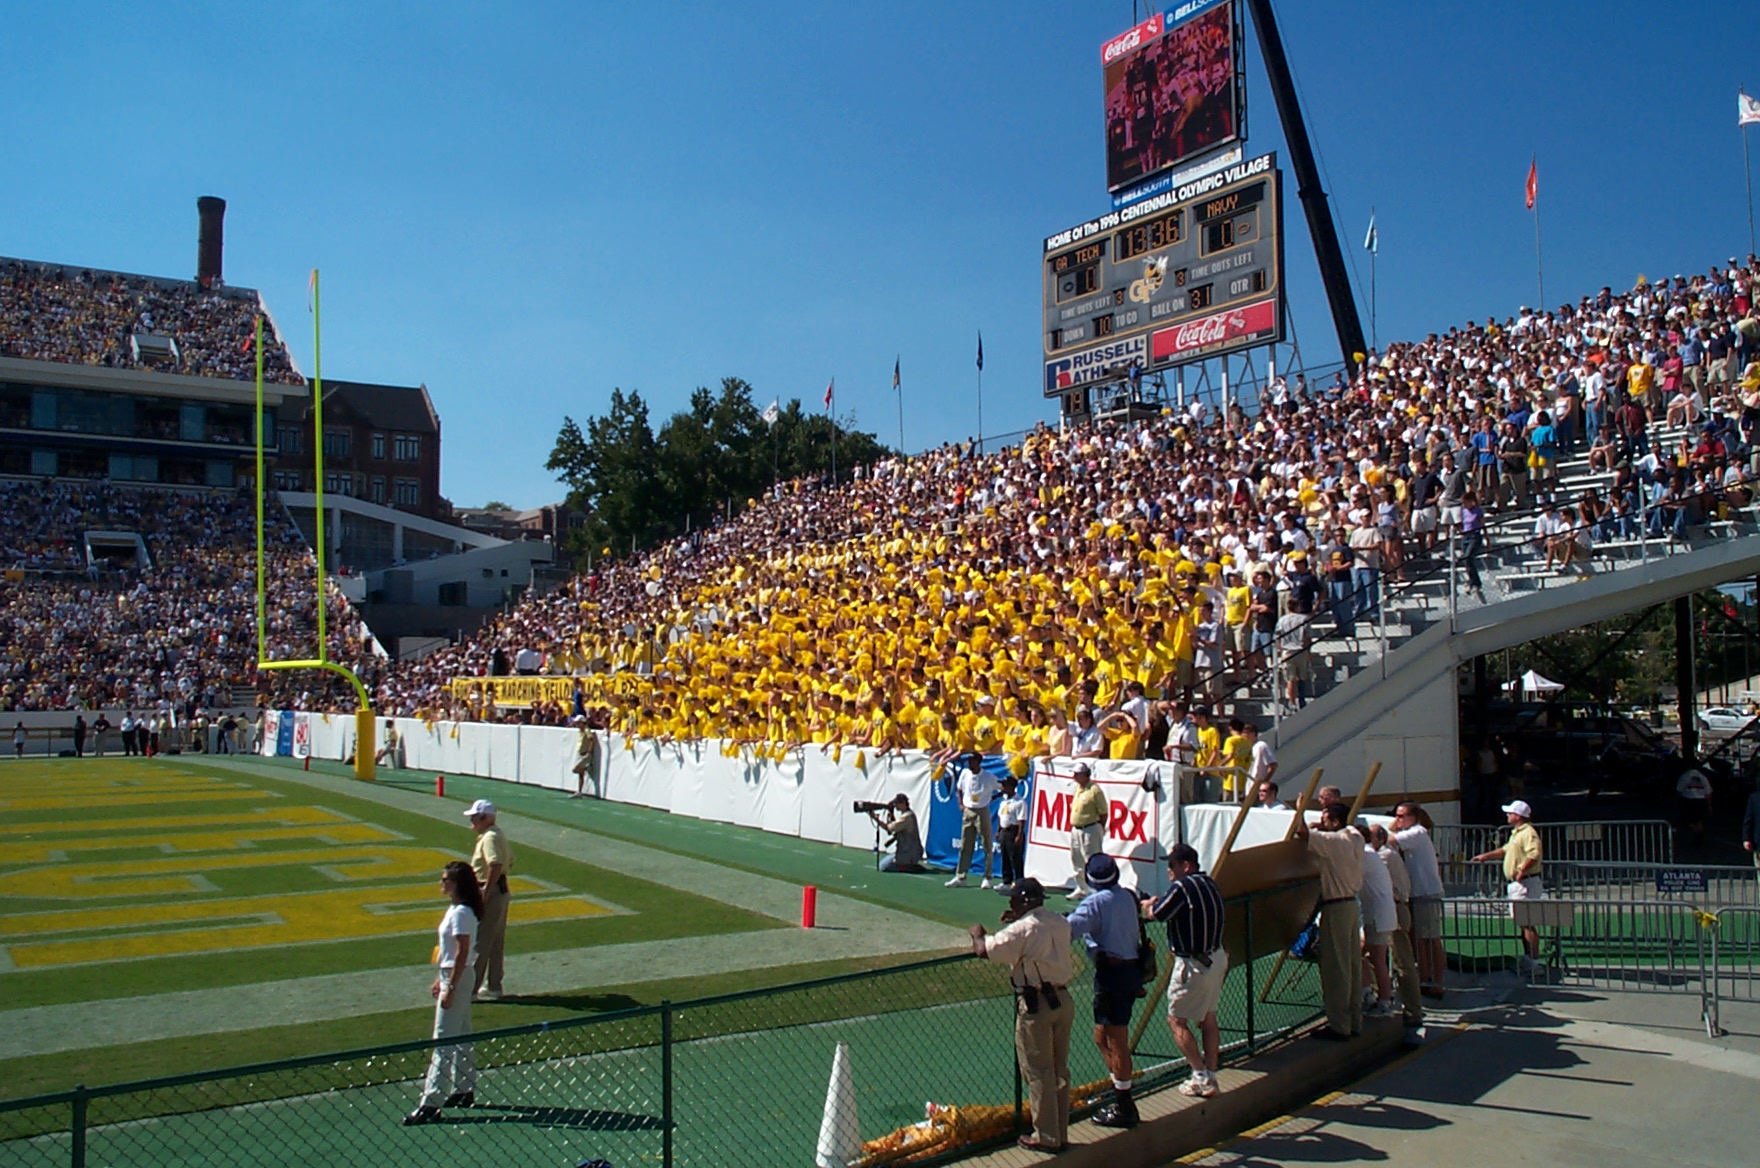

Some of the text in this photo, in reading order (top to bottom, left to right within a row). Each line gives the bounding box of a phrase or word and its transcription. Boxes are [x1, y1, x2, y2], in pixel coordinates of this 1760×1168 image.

[1047, 229, 1072, 250] HOME
[1072, 226, 1083, 240] Of
[1084, 221, 1099, 236] The
[1100, 212, 1119, 231] 1996
[1121, 189, 1178, 222] CENTENNIAL
[1178, 173, 1224, 200] OLYMPIC
[1224, 154, 1270, 183] VILLAGE
[1206, 193, 1239, 218] NAVY
[1075, 244, 1100, 263] TECH
[1191, 266, 1208, 279] TIME
[1211, 259, 1231, 274] OUTS
[1234, 251, 1253, 266] LEFT
[1230, 278, 1249, 295] QTR
[1061, 307, 1075, 319] TIME
[1077, 302, 1093, 315] OUTS
[1094, 295, 1111, 310] LEFT
[1151, 301, 1171, 318] BALL
[1172, 297, 1185, 312] ON
[1064, 326, 1084, 343] DOWN
[1073, 338, 1144, 369] RUSSELL
[545, 681, 574, 701] YELLO
